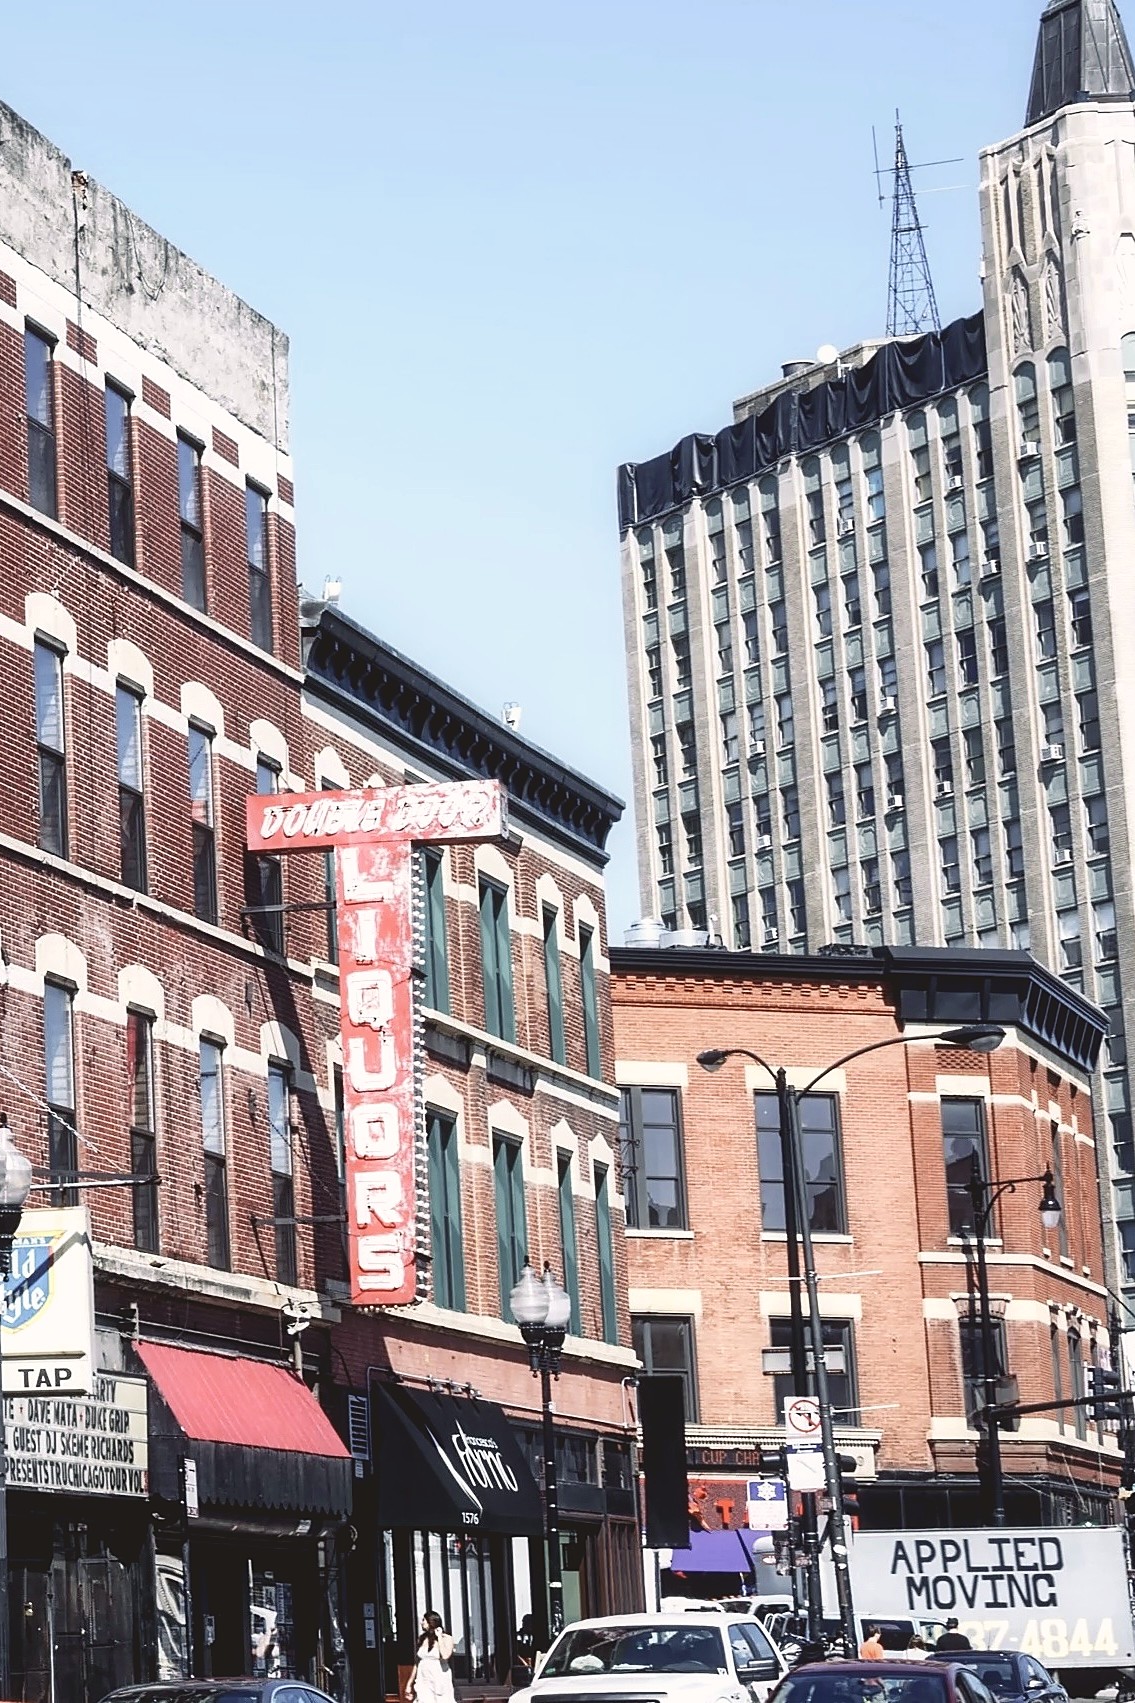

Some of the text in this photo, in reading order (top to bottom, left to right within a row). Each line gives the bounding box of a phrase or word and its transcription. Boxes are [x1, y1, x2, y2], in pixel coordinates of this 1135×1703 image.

[260, 798, 384, 839] DOUBLE
[342, 846, 406, 1291] LIQUORS
[18, 1368, 72, 1388] TAP
[27, 1398, 51, 1424] DAVE
[85, 1405, 107, 1432] DUKE
[108, 1410, 130, 1433] GRIP
[13, 1427, 41, 1453] GUEST
[45, 1430, 57, 1454] DJ
[90, 1437, 134, 1464] RICHARDS
[702, 1450, 726, 1464] CUP
[461, 1512, 479, 1525] 1576
[891, 1537, 1064, 1575] APPLIED
[906, 1573, 1058, 1611] MOVING
